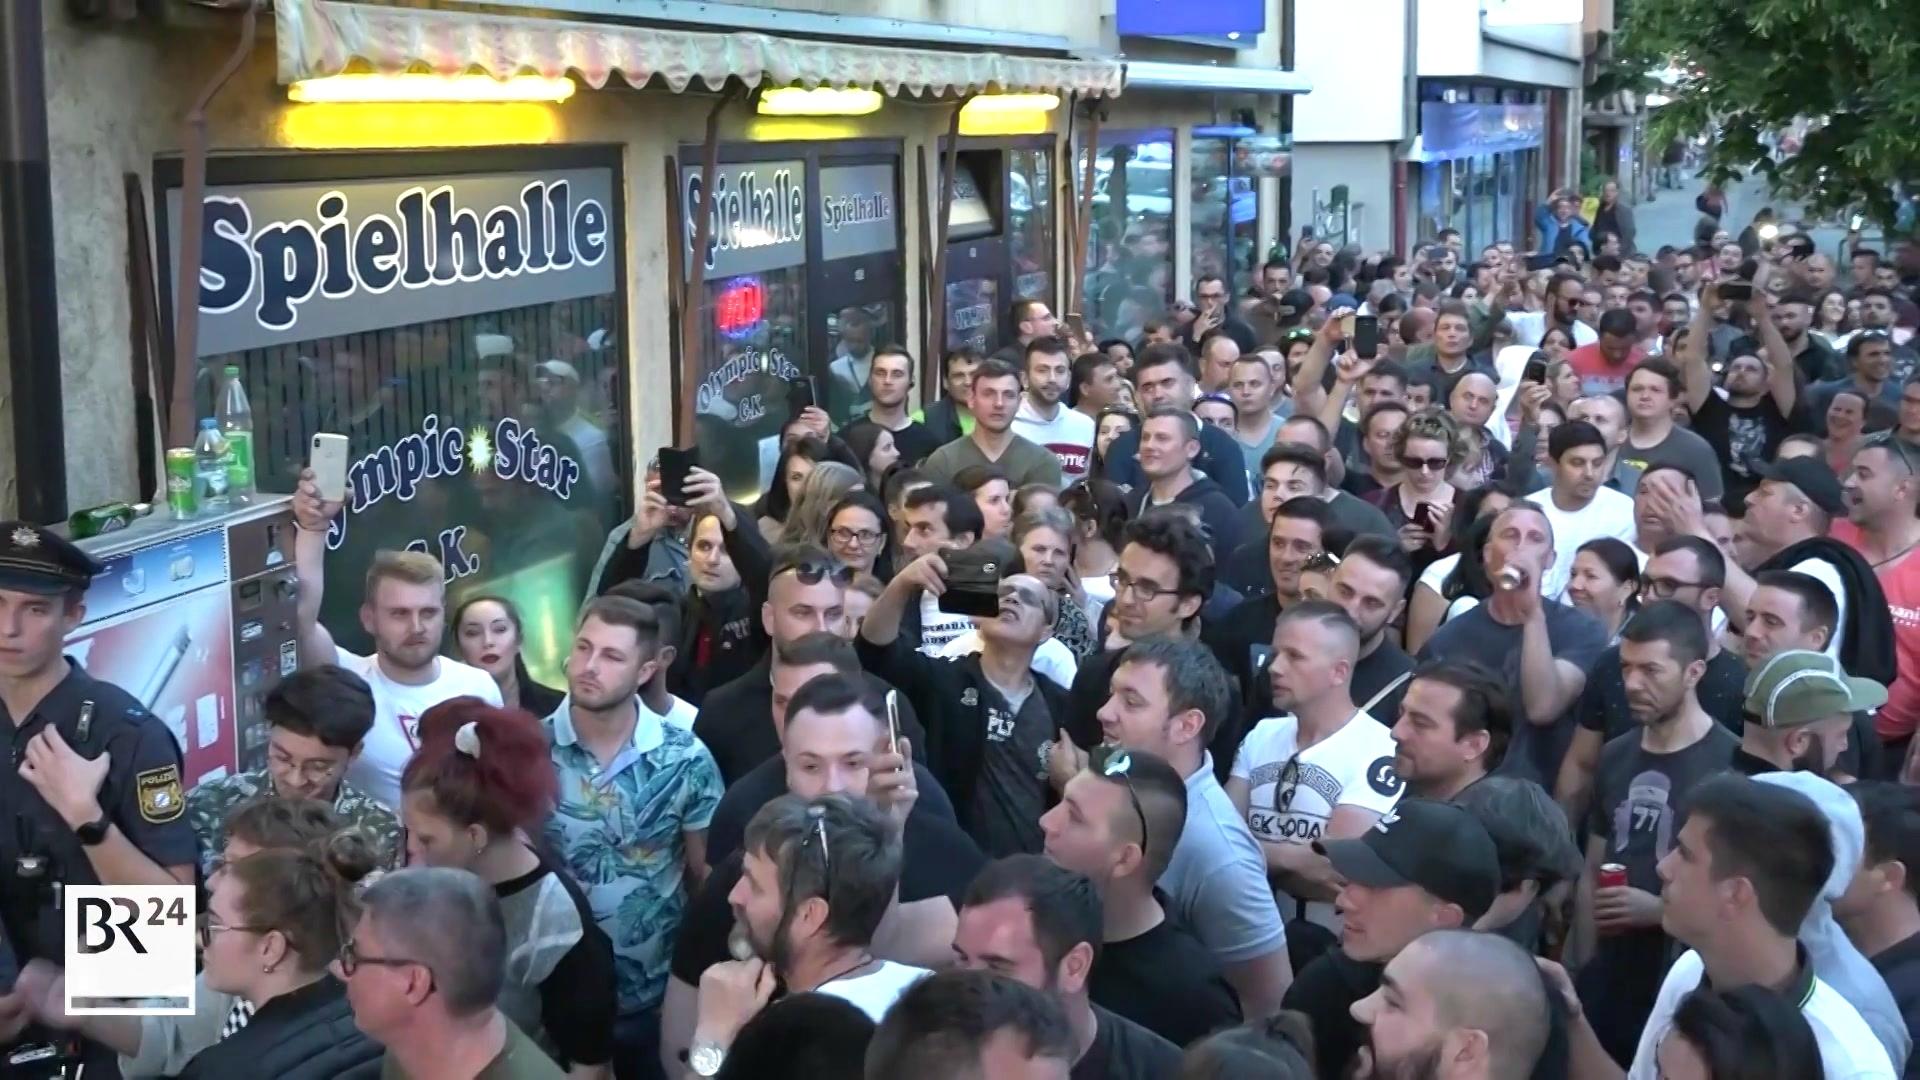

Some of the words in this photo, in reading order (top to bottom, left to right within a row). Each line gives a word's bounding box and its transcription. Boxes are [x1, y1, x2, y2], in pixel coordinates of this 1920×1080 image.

[823, 191, 891, 233] Spielhalle
[198, 179, 607, 330] Spielhalle
[495, 417, 579, 500] Star
[1632, 806, 1661, 832] 77
